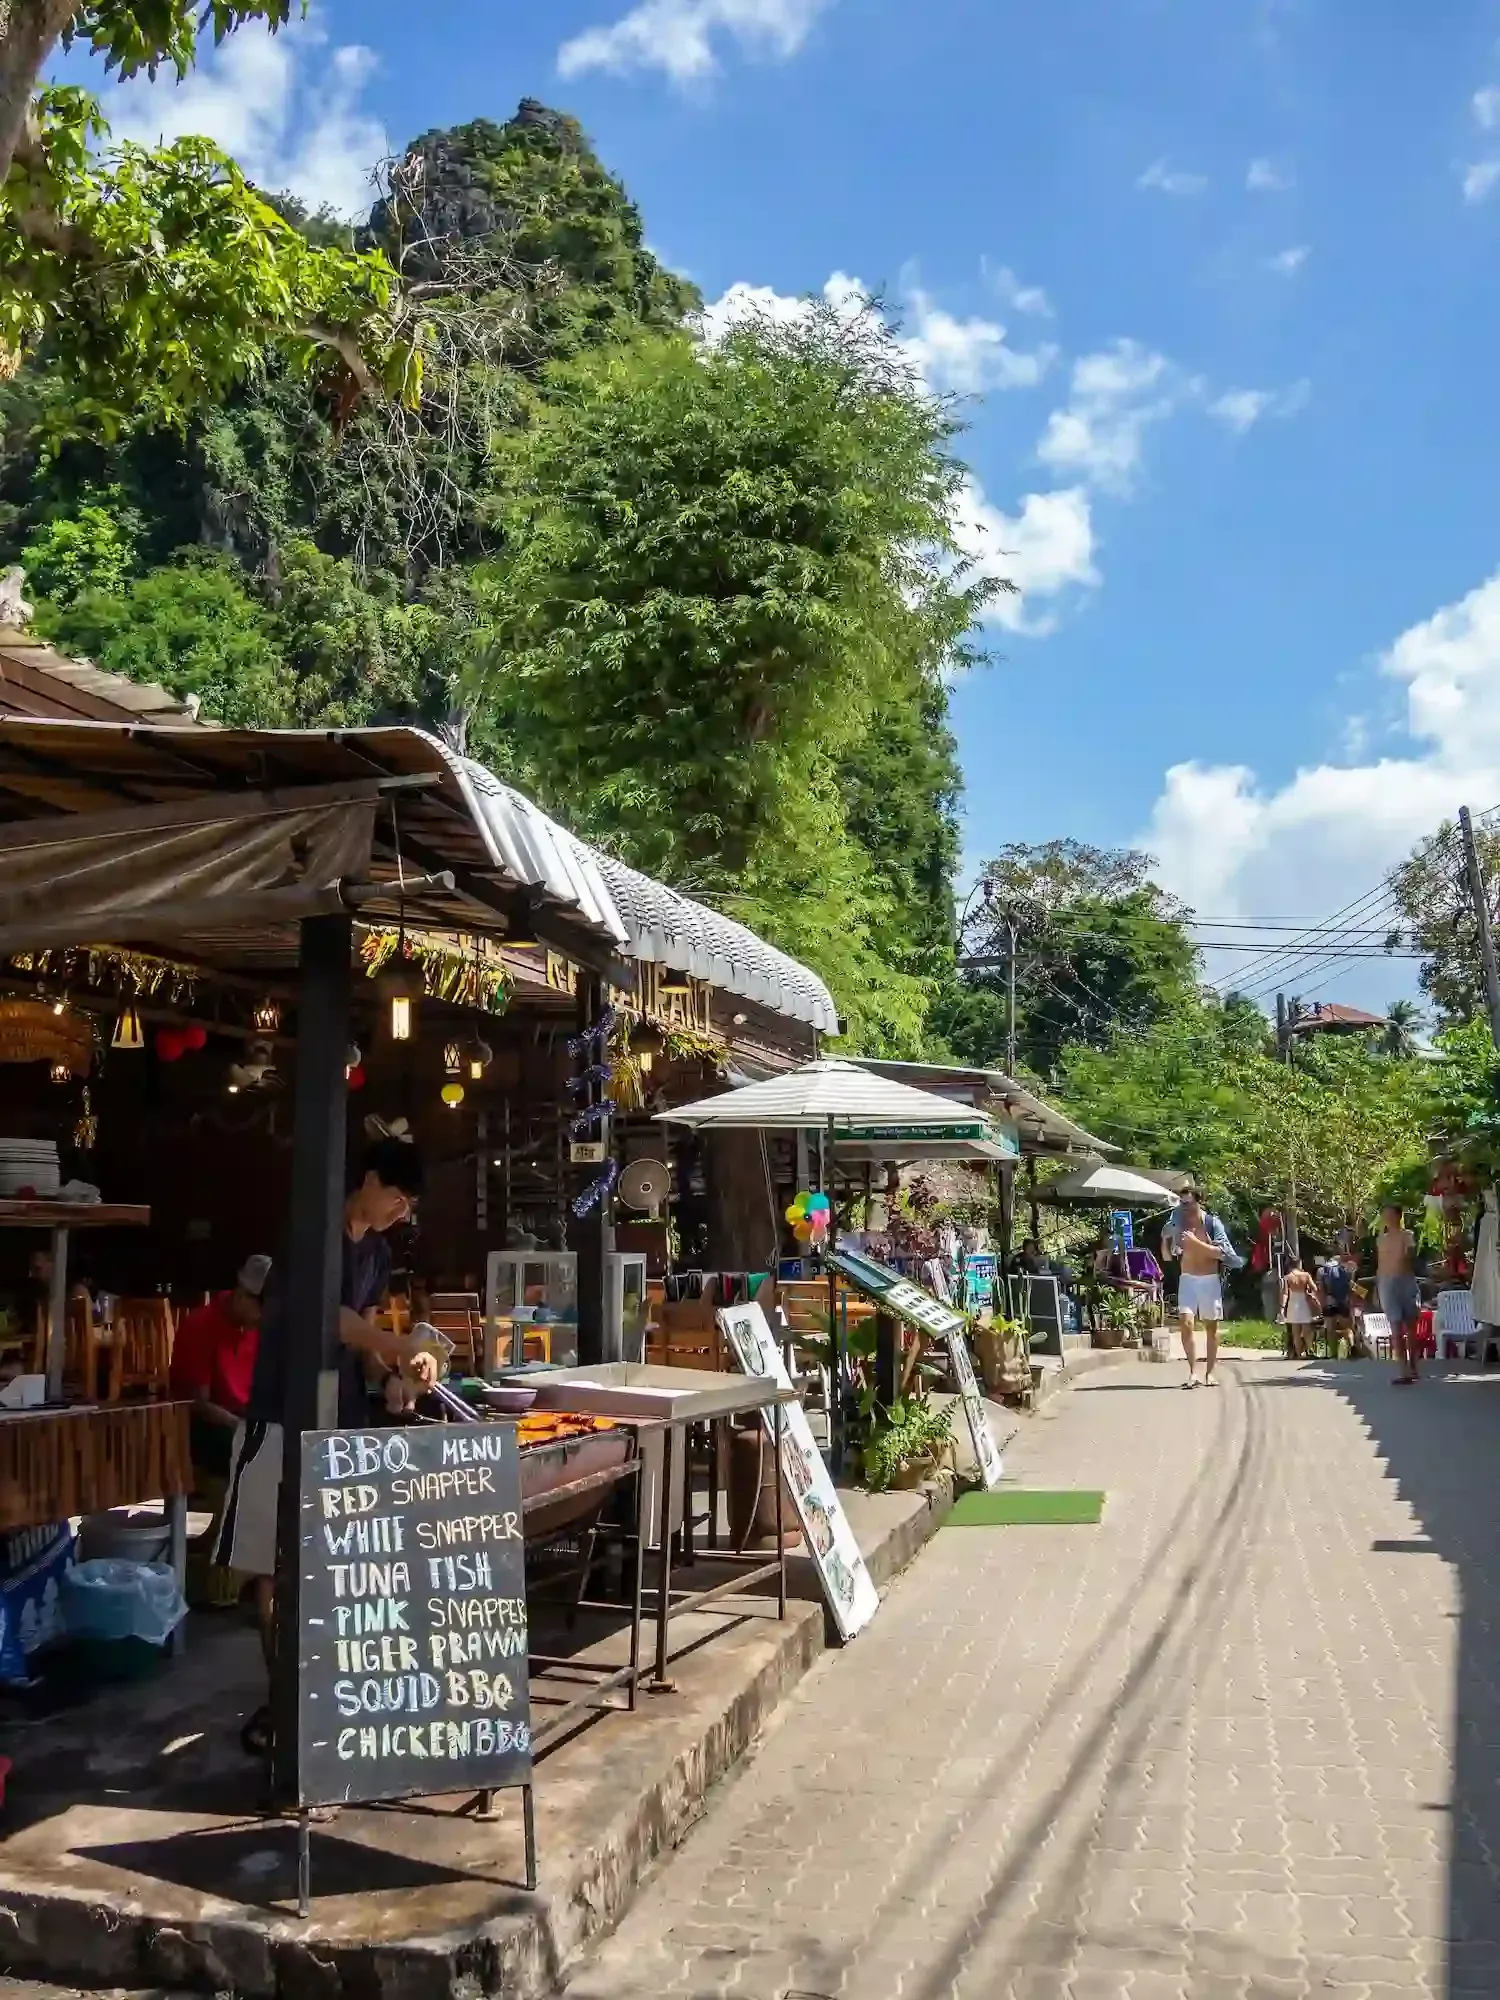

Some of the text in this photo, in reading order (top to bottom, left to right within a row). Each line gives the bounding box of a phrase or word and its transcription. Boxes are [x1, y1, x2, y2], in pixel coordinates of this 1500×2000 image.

[322, 1434, 501, 1480] BBQ MENU
[319, 1466, 496, 1519] RED SNAPPER
[416, 1511, 524, 1549] SNAPPER
[325, 1552, 493, 1598] TUNA FISH
[331, 1597, 529, 1636] PINK SNAPPER
[334, 1626, 529, 1673] TIGER PRAWN
[334, 1668, 514, 1717] SQUID BBQ
[337, 1717, 534, 1761] CHICKEN BBQ
